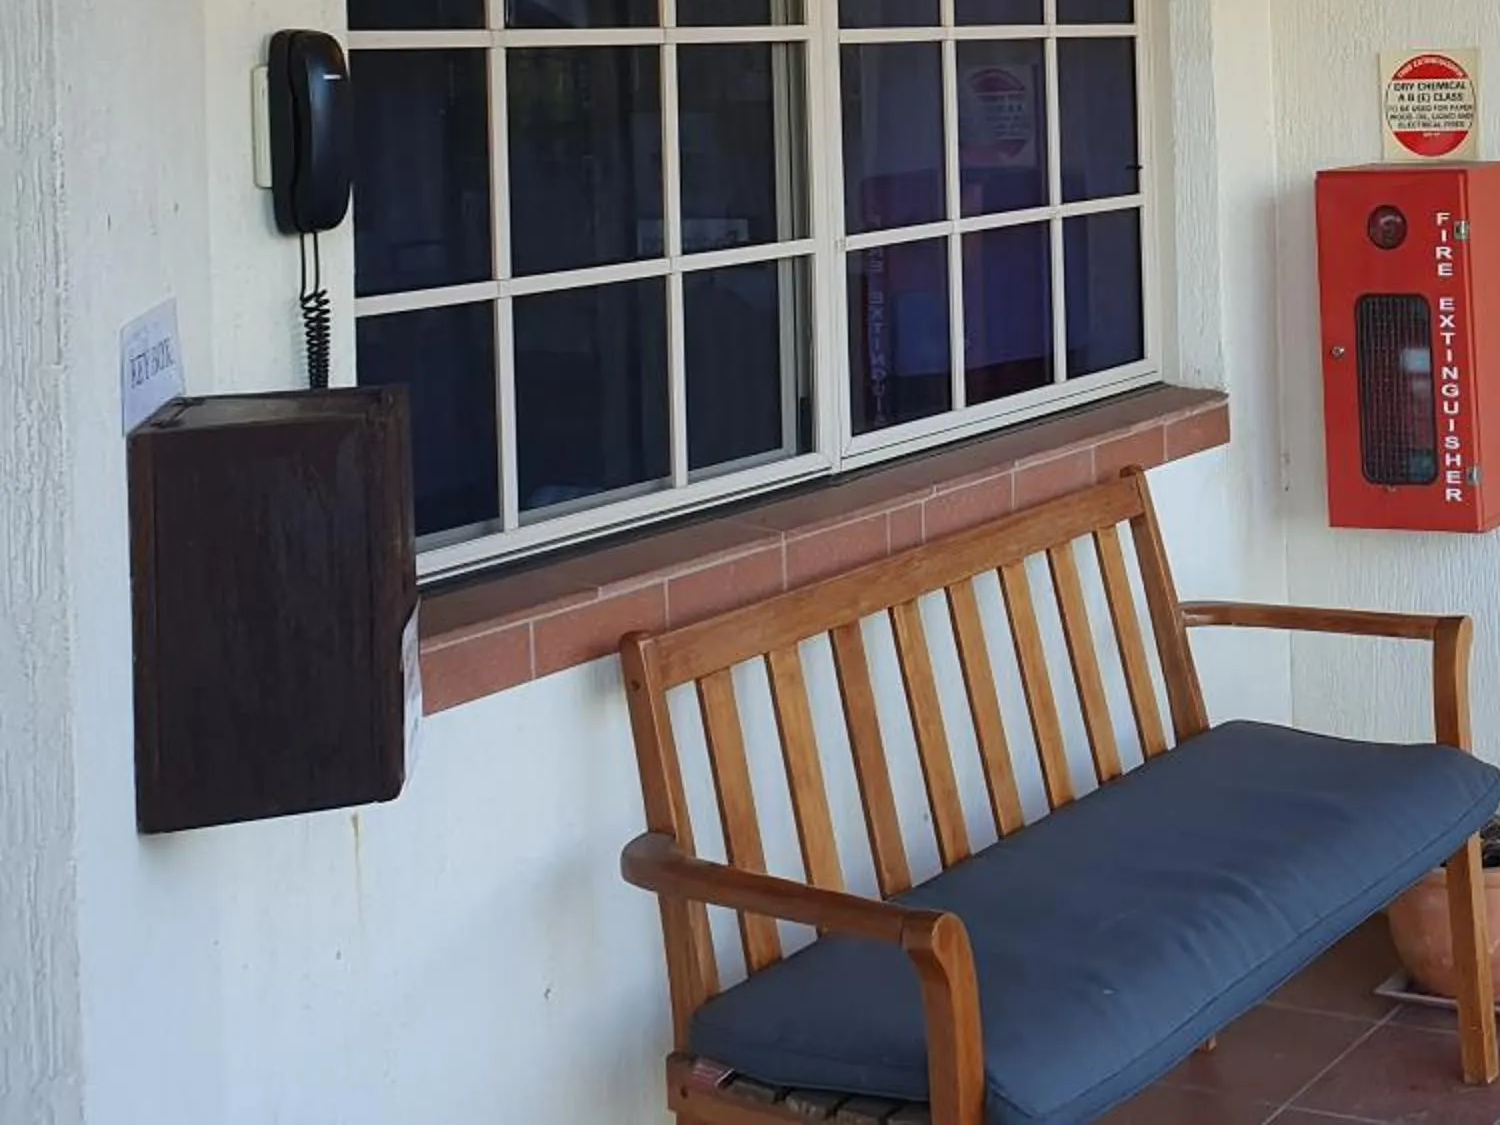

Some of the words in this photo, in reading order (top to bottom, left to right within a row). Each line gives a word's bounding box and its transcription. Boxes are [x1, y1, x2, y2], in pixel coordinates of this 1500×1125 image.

[1417, 82, 1465, 90] CHEMICAL
[1434, 93, 1463, 101] CLASS
[1435, 211, 1454, 276] FIRE
[1439, 297, 1463, 503] EXTINGUISHER
